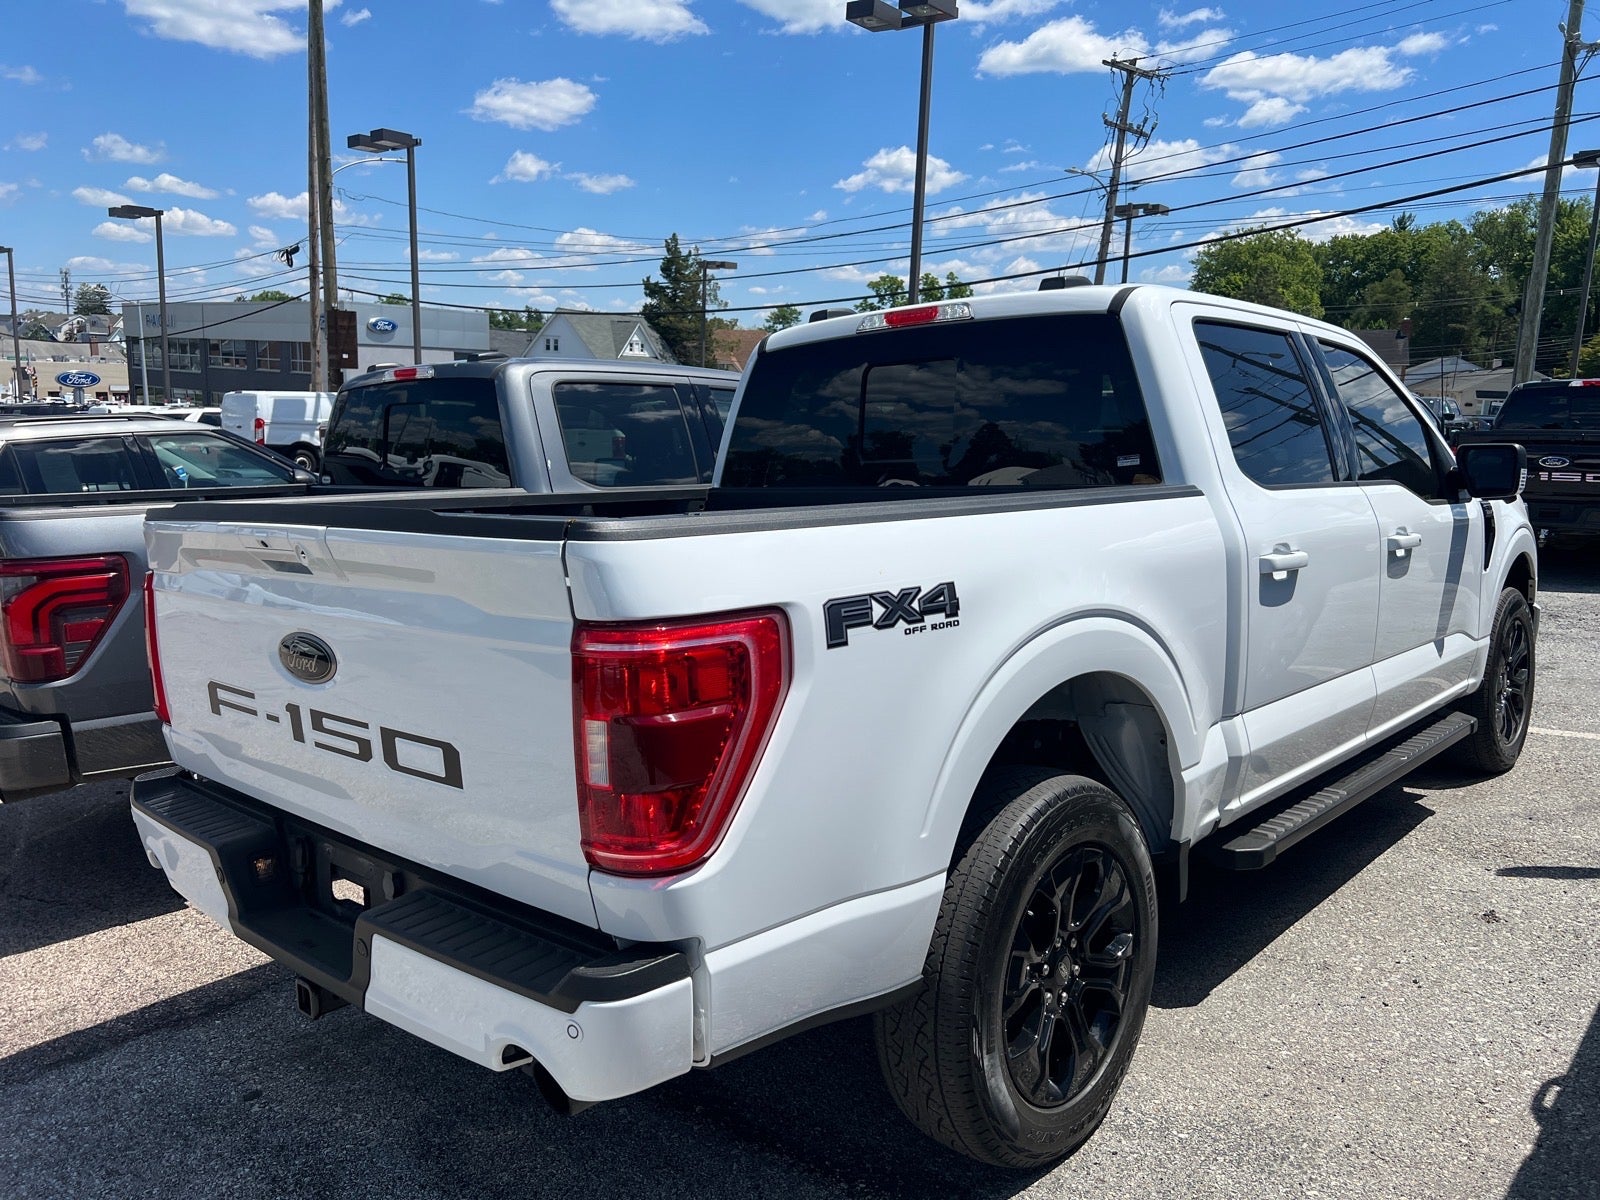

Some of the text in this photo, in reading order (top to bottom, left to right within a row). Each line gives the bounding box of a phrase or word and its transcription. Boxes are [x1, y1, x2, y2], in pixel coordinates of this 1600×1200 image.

[66, 374, 92, 384] Ford
[822, 581, 960, 650] FX4
[904, 619, 960, 636] OFF ROAD
[287, 639, 319, 673] Ford
[207, 680, 464, 790] F-150
